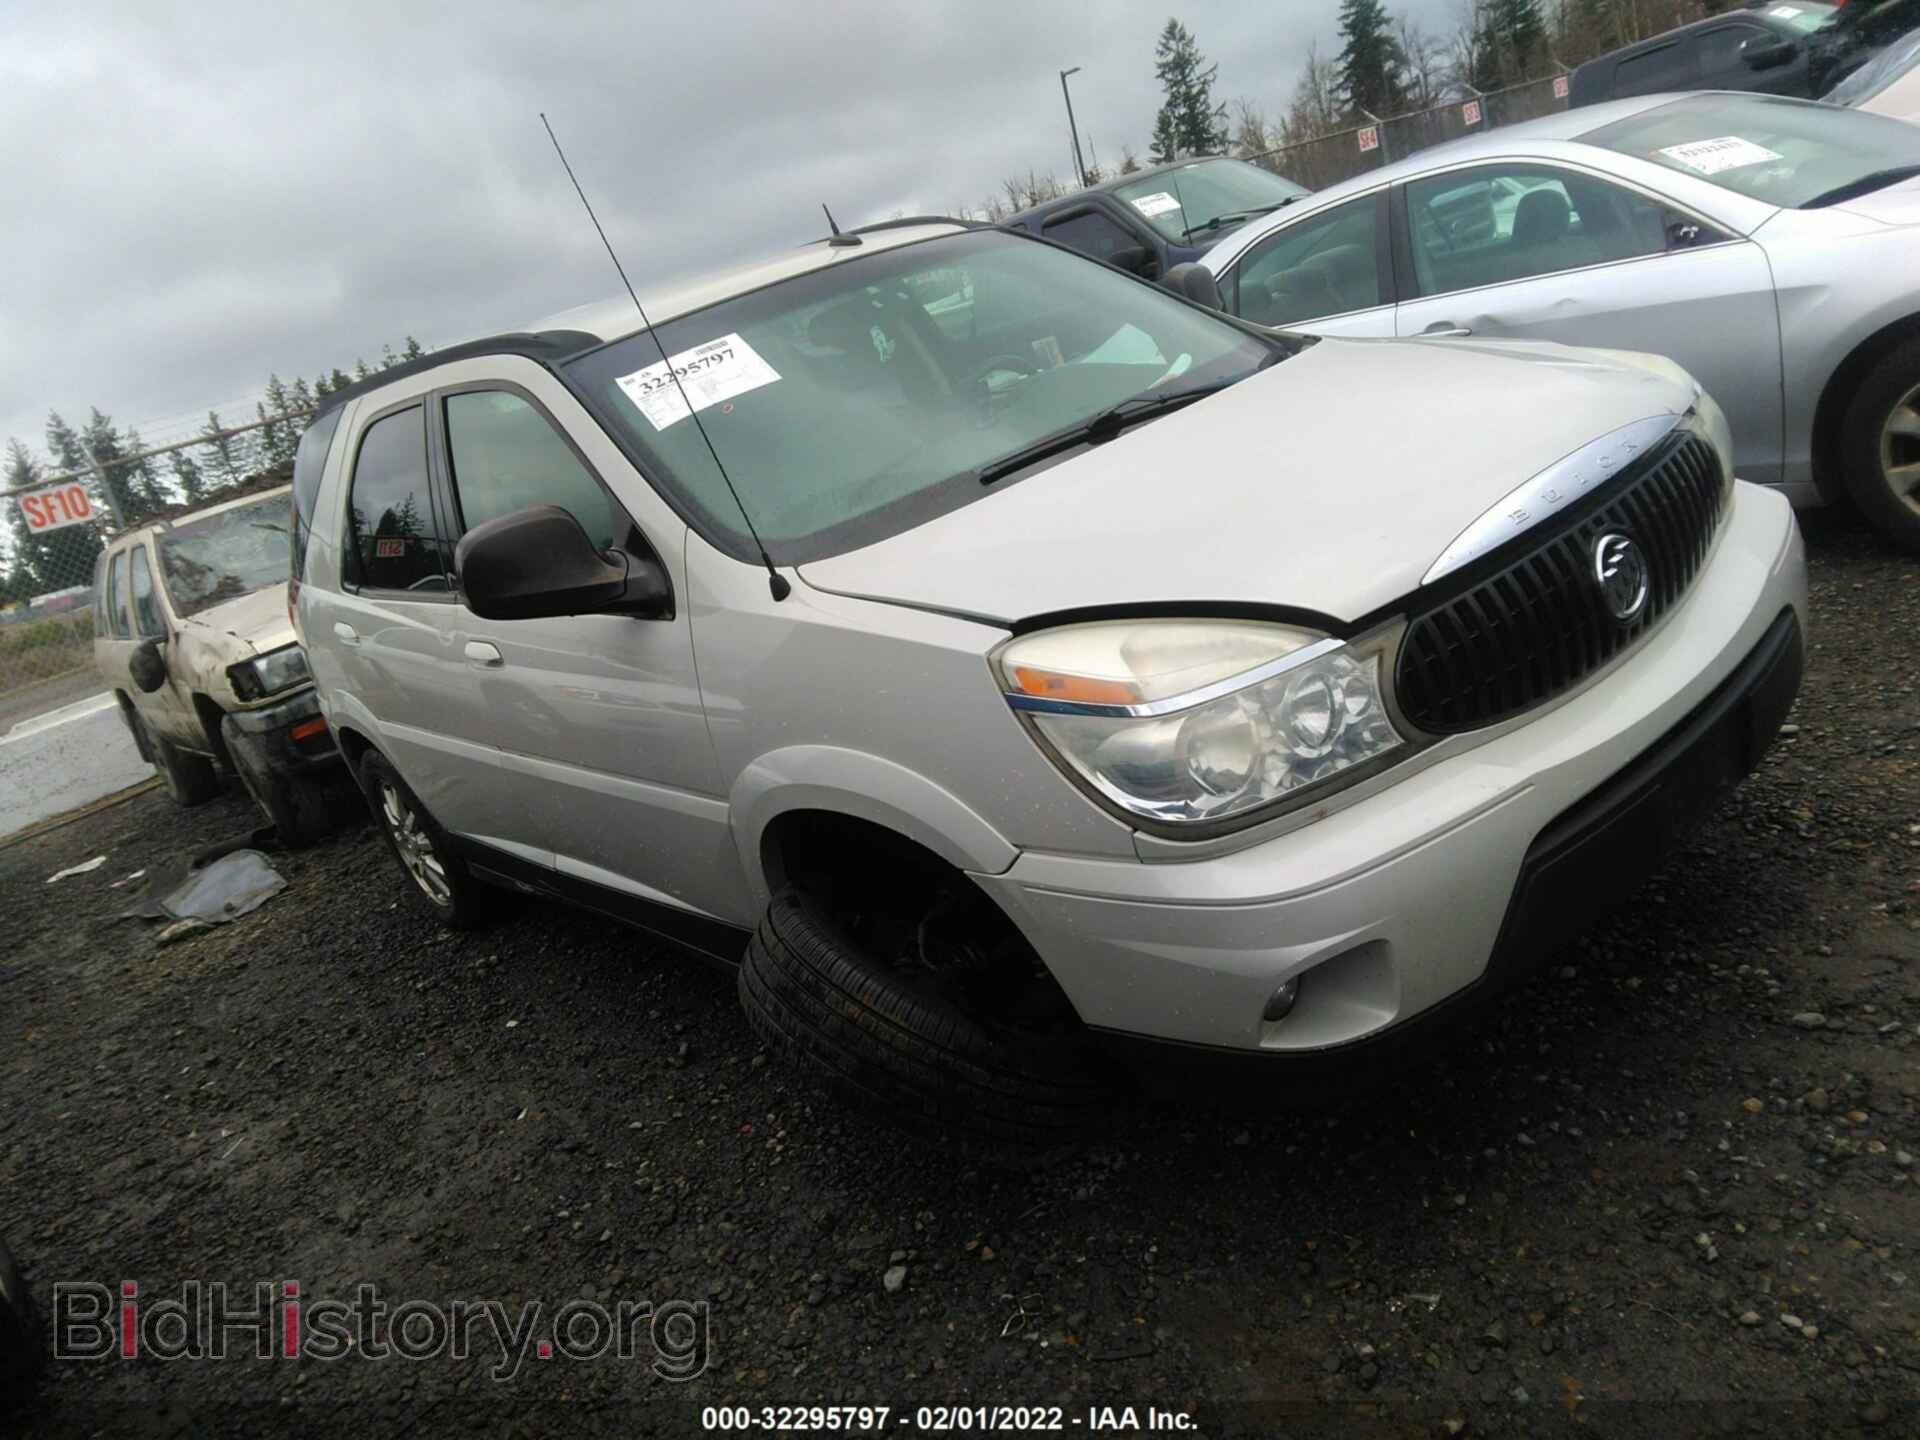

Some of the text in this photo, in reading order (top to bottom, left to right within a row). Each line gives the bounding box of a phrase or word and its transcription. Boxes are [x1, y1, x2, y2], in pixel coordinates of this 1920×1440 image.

[639, 347, 736, 395] 32295797
[1507, 437, 1640, 526] BUICK
[21, 484, 91, 528] SF10
